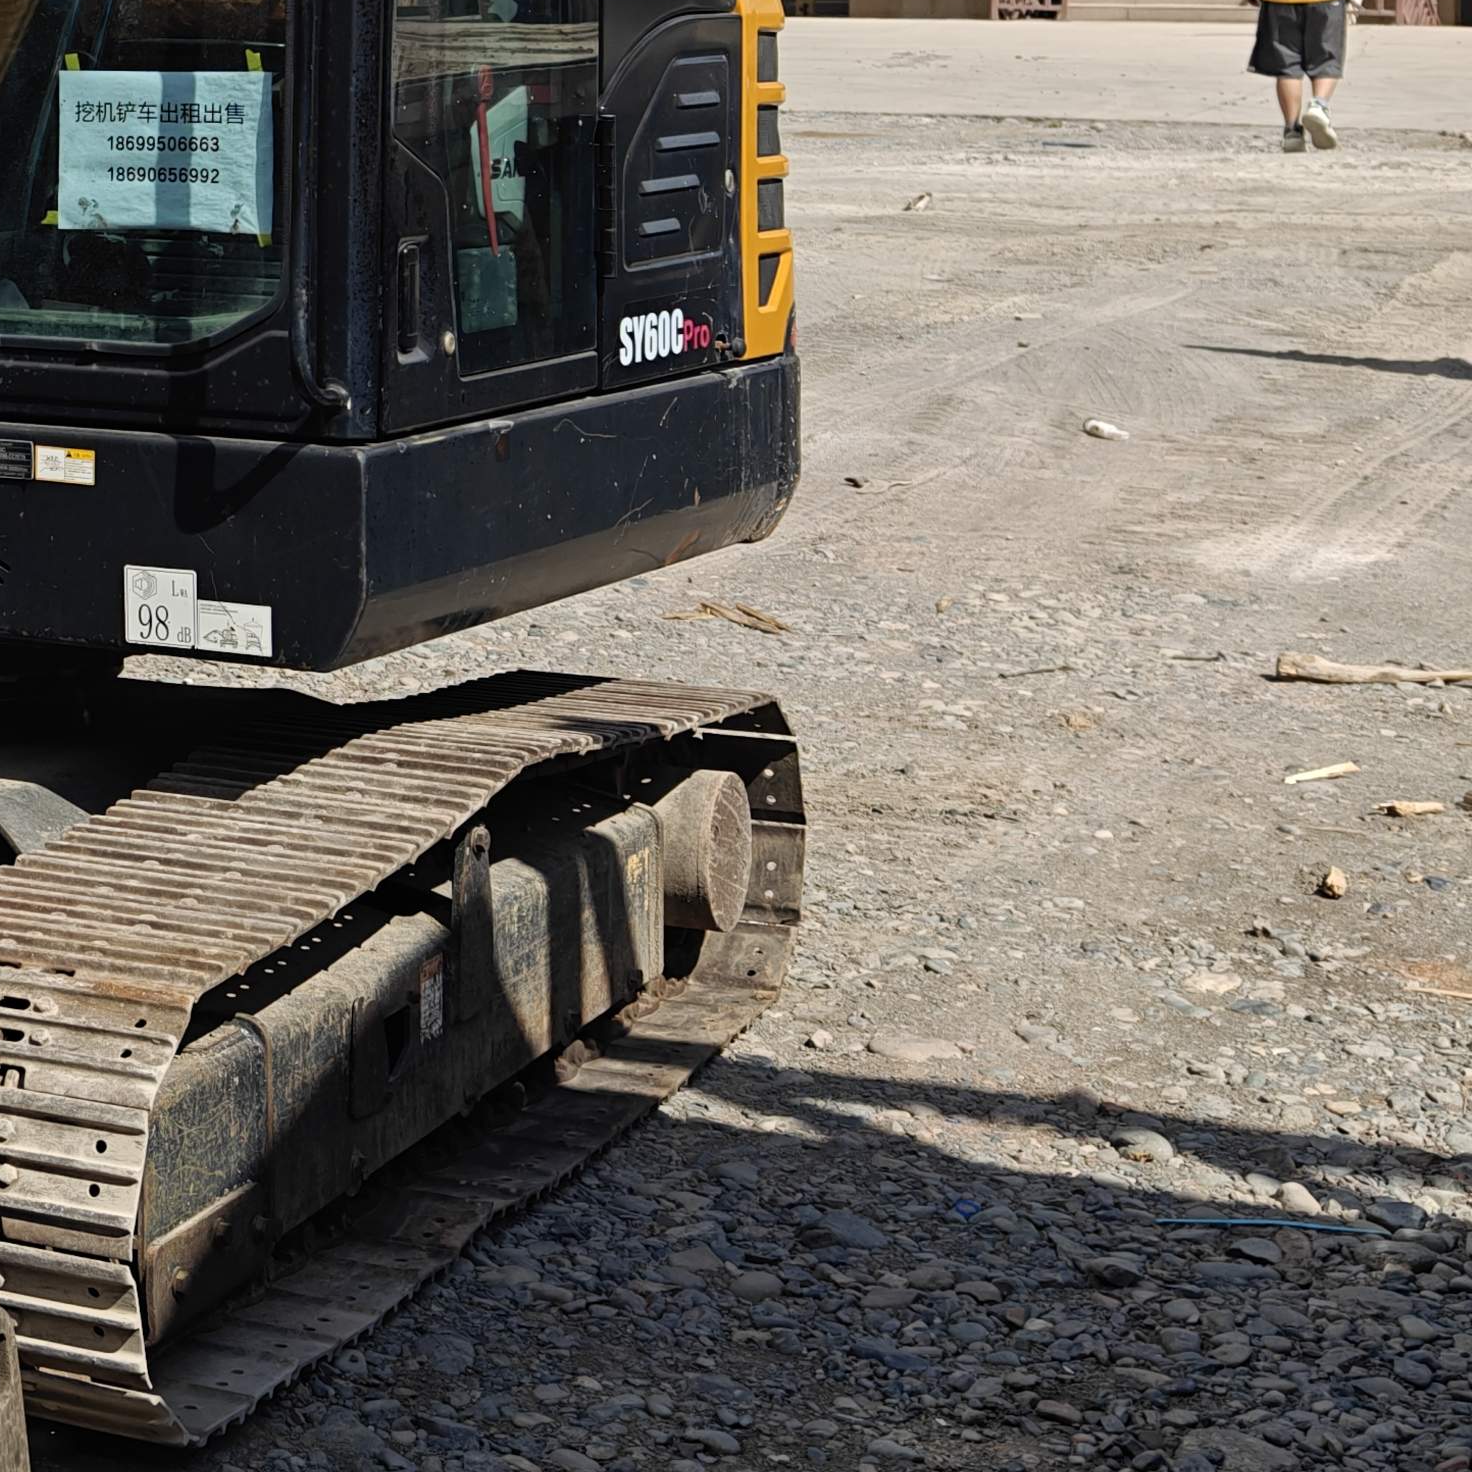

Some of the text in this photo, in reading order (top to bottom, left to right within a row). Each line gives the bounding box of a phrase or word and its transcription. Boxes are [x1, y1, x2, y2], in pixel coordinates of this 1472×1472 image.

[75, 101, 245, 125] 挖机铲车出租出售
[107, 135, 221, 153] 18699506663
[107, 166, 220, 184] 18690656992
[138, 603, 170, 641] 98
[176, 626, 192, 644] dB
